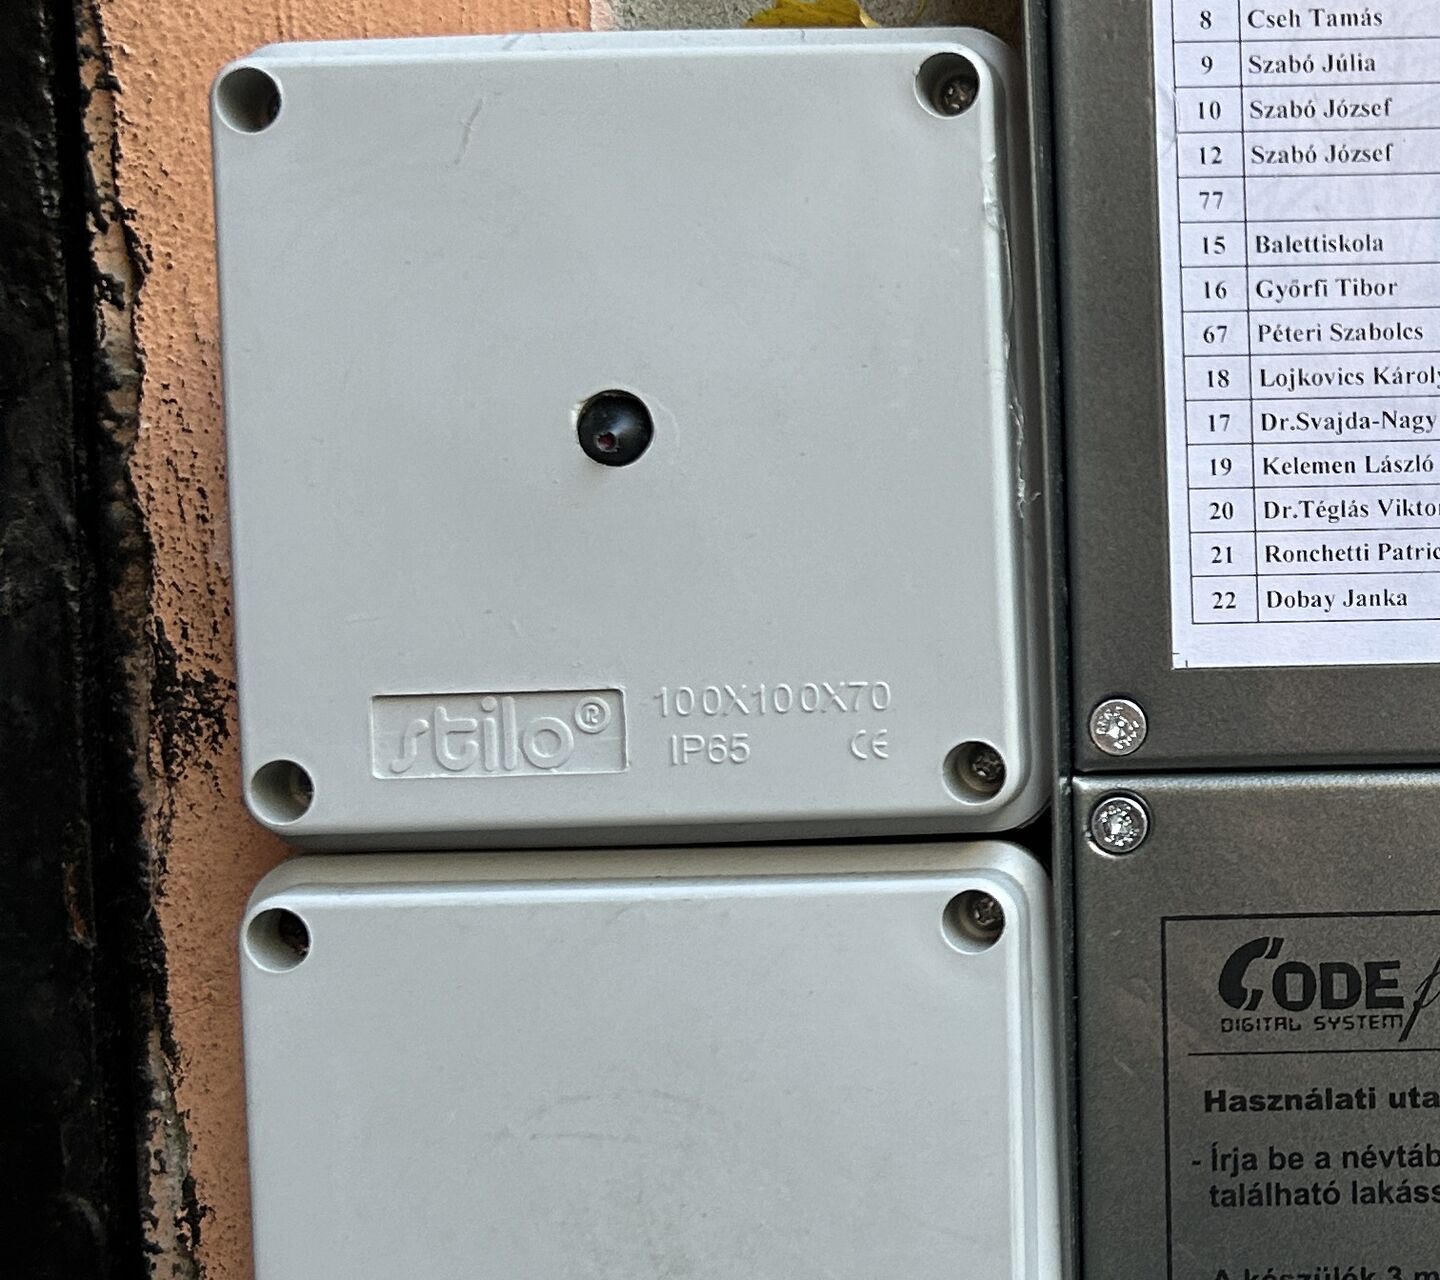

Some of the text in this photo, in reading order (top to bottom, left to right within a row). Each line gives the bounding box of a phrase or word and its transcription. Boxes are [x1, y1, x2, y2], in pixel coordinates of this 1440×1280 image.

[1199, 97, 1393, 120] 10 Szabó József
[1208, 413, 1231, 433] 17
[1210, 453, 1434, 476] 19 Kelemen László
[1209, 501, 1234, 521] 20
[1263, 499, 1369, 524] Dr.Téglás
[1211, 545, 1233, 564] 21
[1265, 543, 1369, 563] Ronchetti
[1211, 588, 1408, 613] 22 Dobay Janka
[670, 732, 752, 767] IP65
[1220, 1013, 1404, 1034] DIGITAL SYSTEM
[1203, 1086, 1377, 1113] Használati
[1211, 1140, 1258, 1178] Írja
[1268, 1145, 1305, 1171] be
[1314, 1151, 1331, 1170] a
[1208, 1179, 1341, 1208] található
